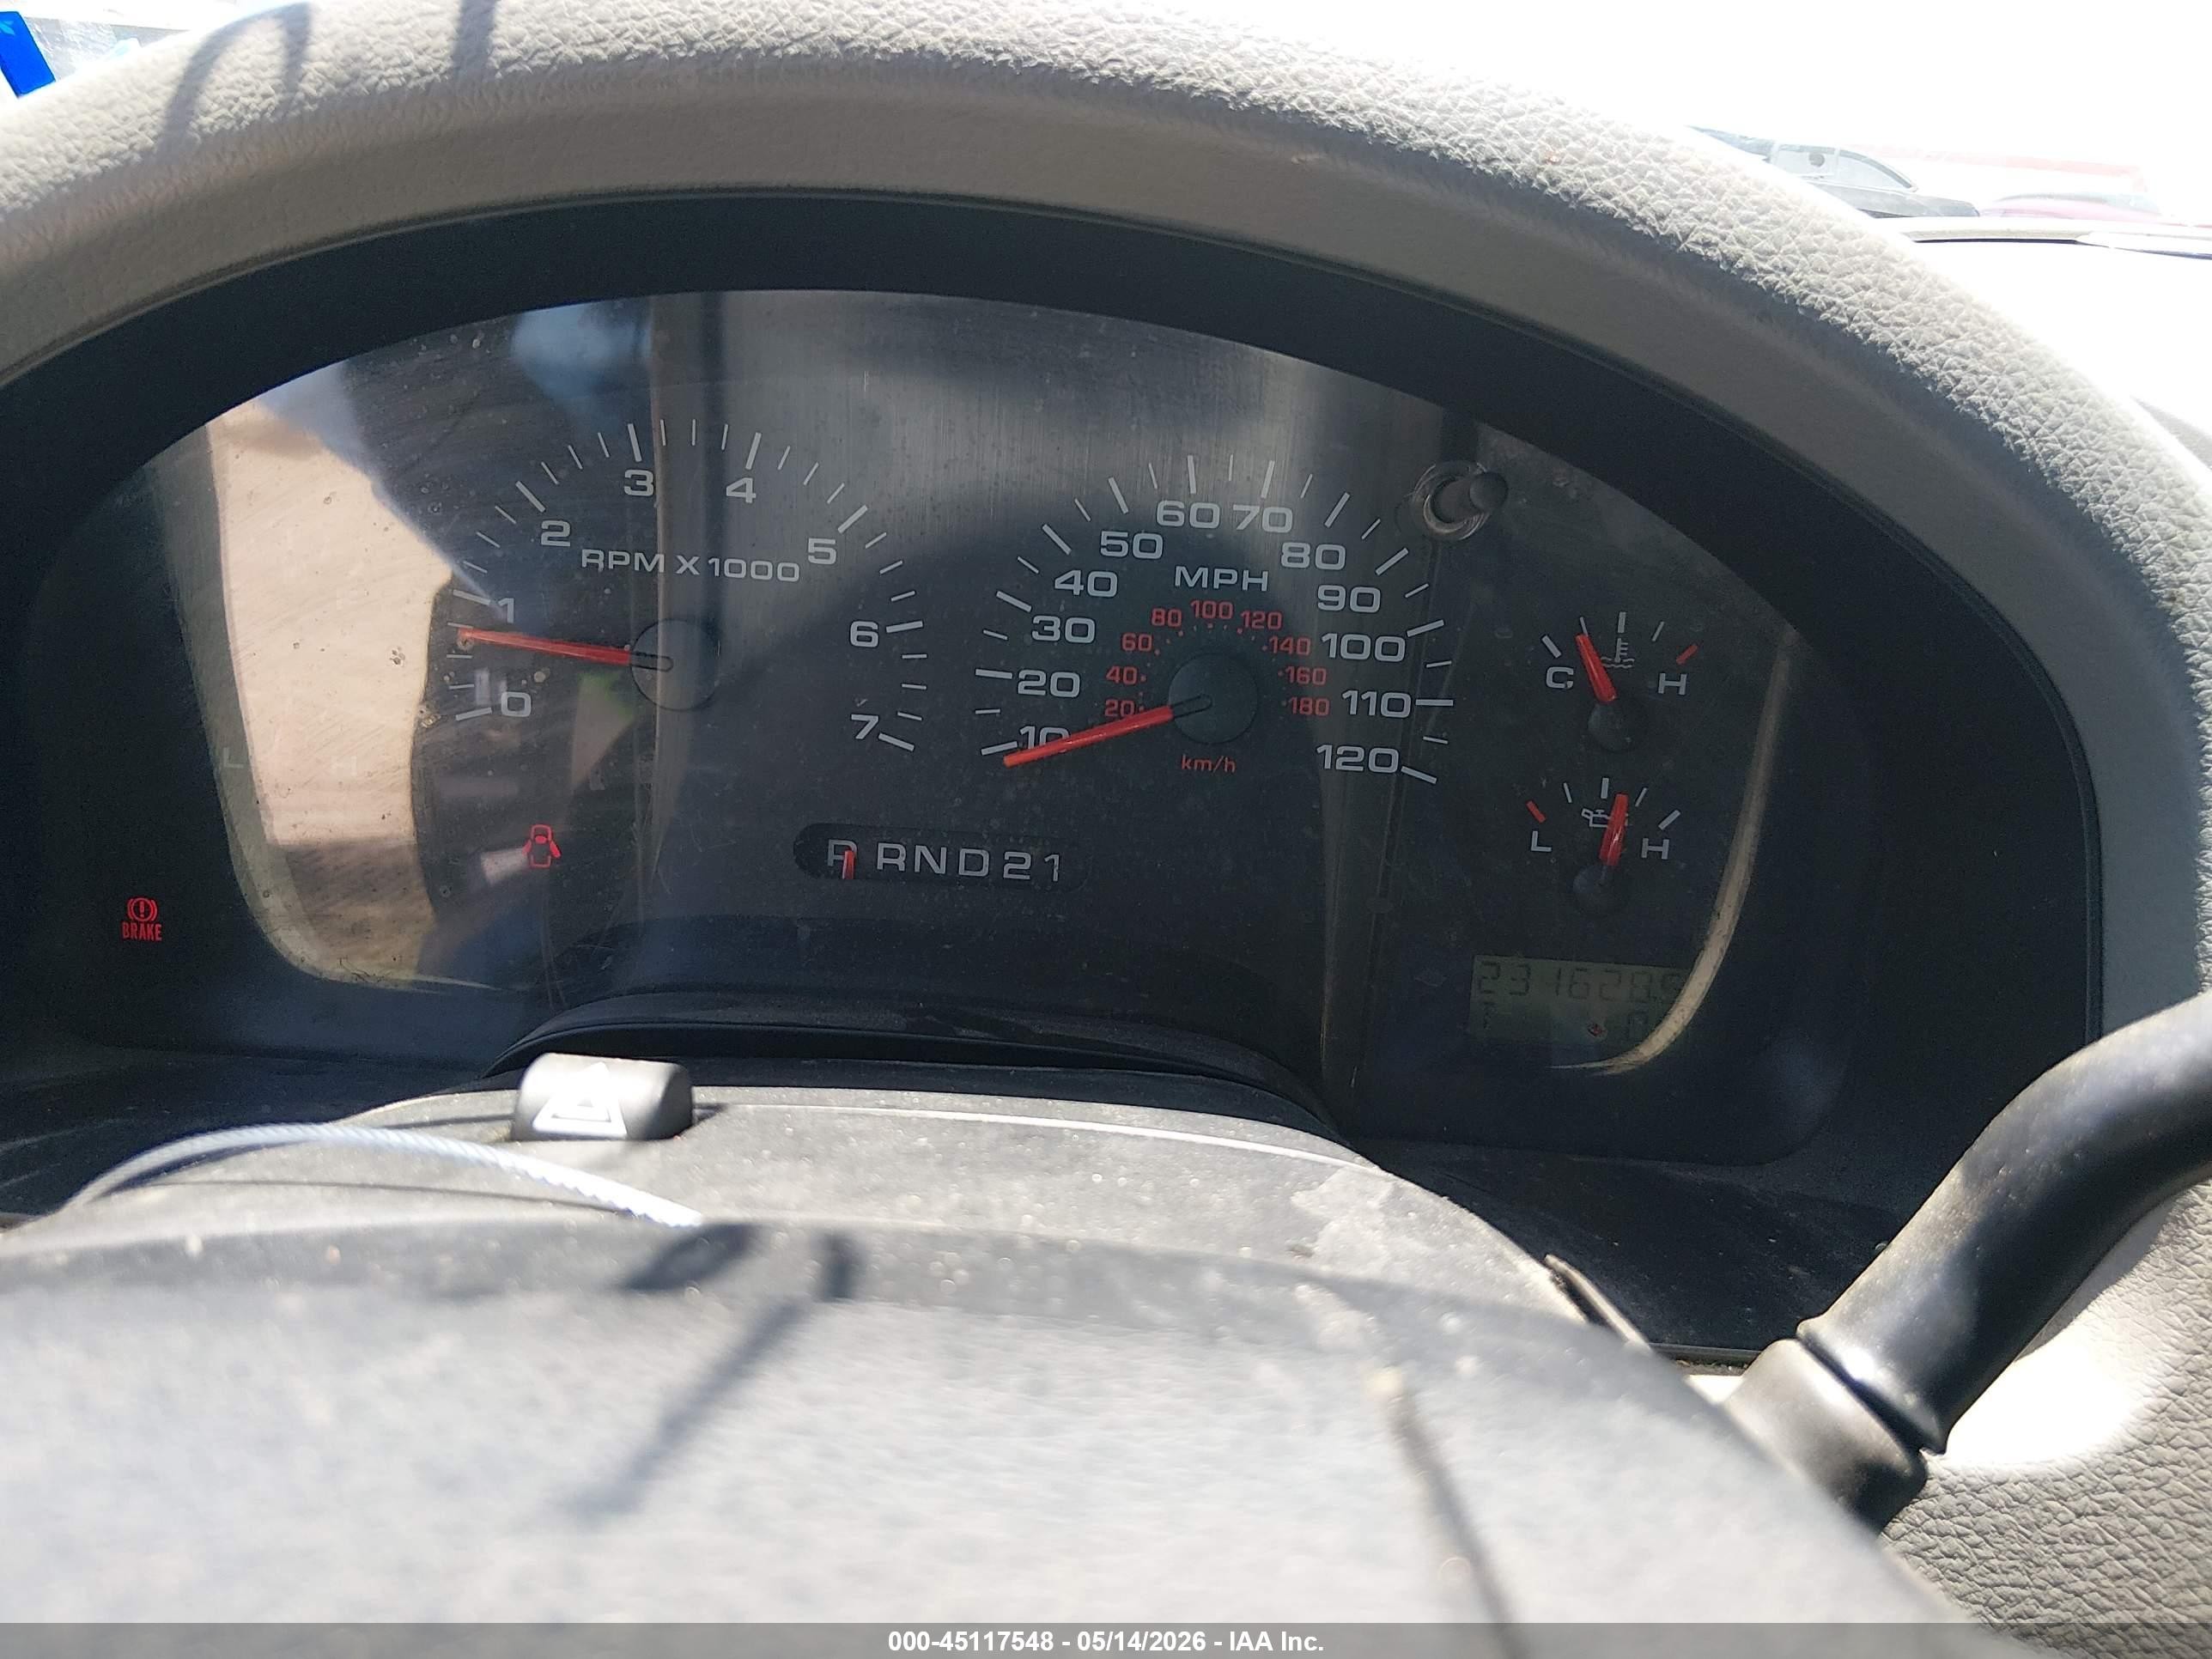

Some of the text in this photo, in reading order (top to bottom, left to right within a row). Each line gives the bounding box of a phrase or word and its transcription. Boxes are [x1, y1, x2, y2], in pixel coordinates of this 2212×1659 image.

[624, 470, 654, 496] 3
[726, 477, 756, 503] 4
[1157, 500, 1220, 529] 60
[1232, 504, 1293, 533] 70
[541, 520, 571, 547] 2
[1100, 531, 1163, 559] 50
[807, 538, 837, 565] 5
[1280, 542, 1346, 570] 80
[581, 549, 799, 582] RPM X 1000
[1054, 570, 1117, 598] 40
[1175, 566, 1268, 592] MPH
[498, 598, 514, 623] 1
[1190, 600, 1233, 620] 100
[1317, 585, 1381, 613] 90
[1031, 616, 1096, 644] 30
[1151, 607, 1182, 628] 80
[1240, 611, 1283, 630] 120
[850, 621, 878, 647] 6
[1121, 633, 1152, 652] 60
[1268, 636, 1310, 655] 140
[1322, 633, 1406, 663] 100
[1018, 670, 1081, 699] 20
[1106, 666, 1138, 685] 40
[1285, 666, 1327, 686] 160
[1546, 666, 1574, 689] C
[1658, 673, 1687, 695] H
[501, 691, 532, 717] 0
[1105, 699, 1135, 717] 20
[1288, 696, 1330, 716] 180
[1342, 690, 1411, 719] 110
[851, 714, 879, 739] 7
[1182, 755, 1237, 773] km/h
[1317, 744, 1400, 773] 120
[1531, 831, 1552, 853] L
[1641, 837, 1669, 860] H
[122, 921, 162, 941] BRAKE
